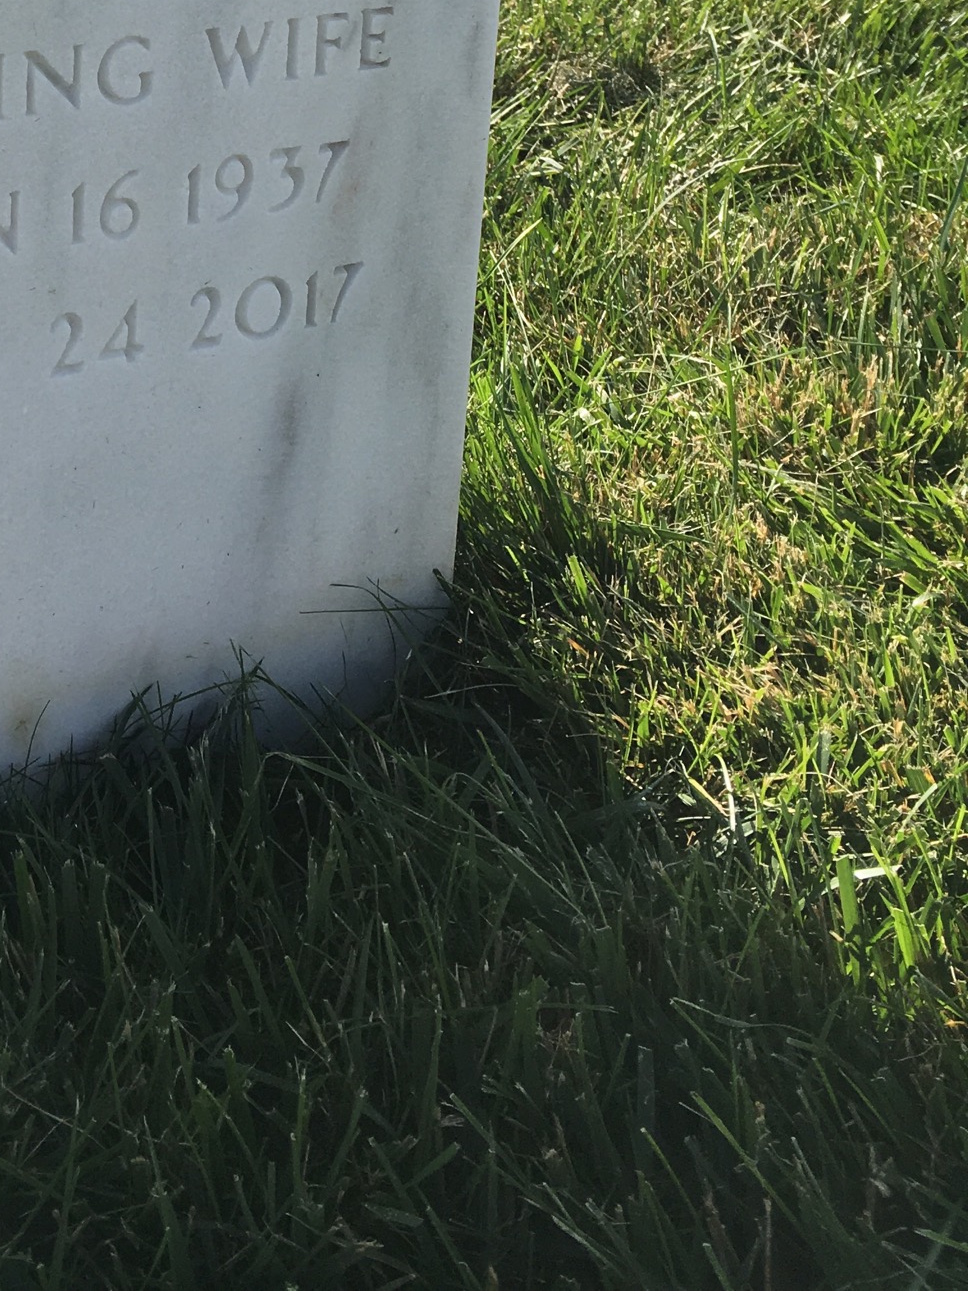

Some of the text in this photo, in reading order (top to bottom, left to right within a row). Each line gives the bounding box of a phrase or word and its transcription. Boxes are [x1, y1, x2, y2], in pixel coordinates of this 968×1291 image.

[204, 6, 395, 90] WIFE
[71, 168, 142, 245] 16
[186, 138, 351, 224] 1937
[50, 299, 145, 378] 24
[188, 261, 365, 351] 2017
